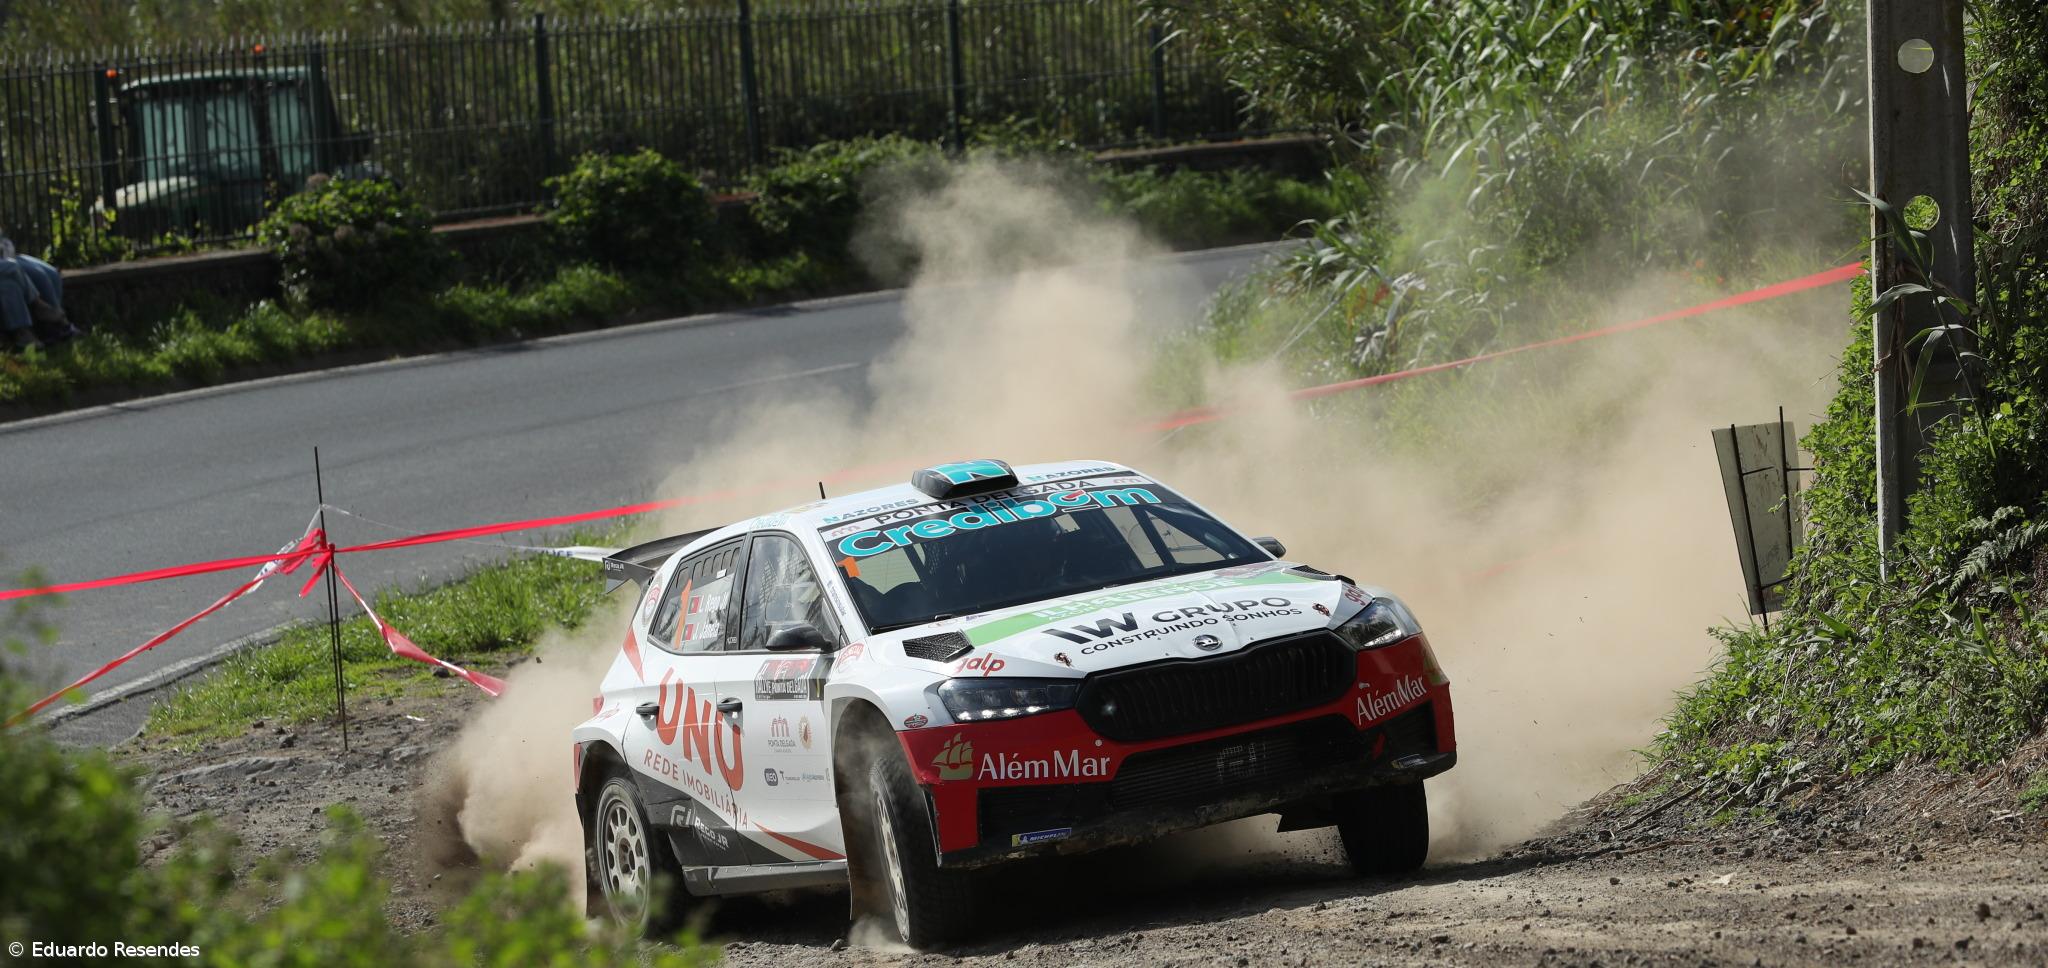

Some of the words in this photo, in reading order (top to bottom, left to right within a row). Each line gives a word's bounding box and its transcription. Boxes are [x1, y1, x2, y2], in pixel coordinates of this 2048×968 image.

[838, 487, 1162, 557] Credibom
[874, 499, 966, 525] PONTA
[973, 479, 1097, 503] DELGADA
[1081, 618, 1218, 655] CONSTRUINDO
[1222, 608, 1303, 622] SONHOS
[1152, 597, 1292, 623] GRUPO
[644, 748, 679, 781] REDE
[682, 769, 749, 830] IMOBILIÁRIA
